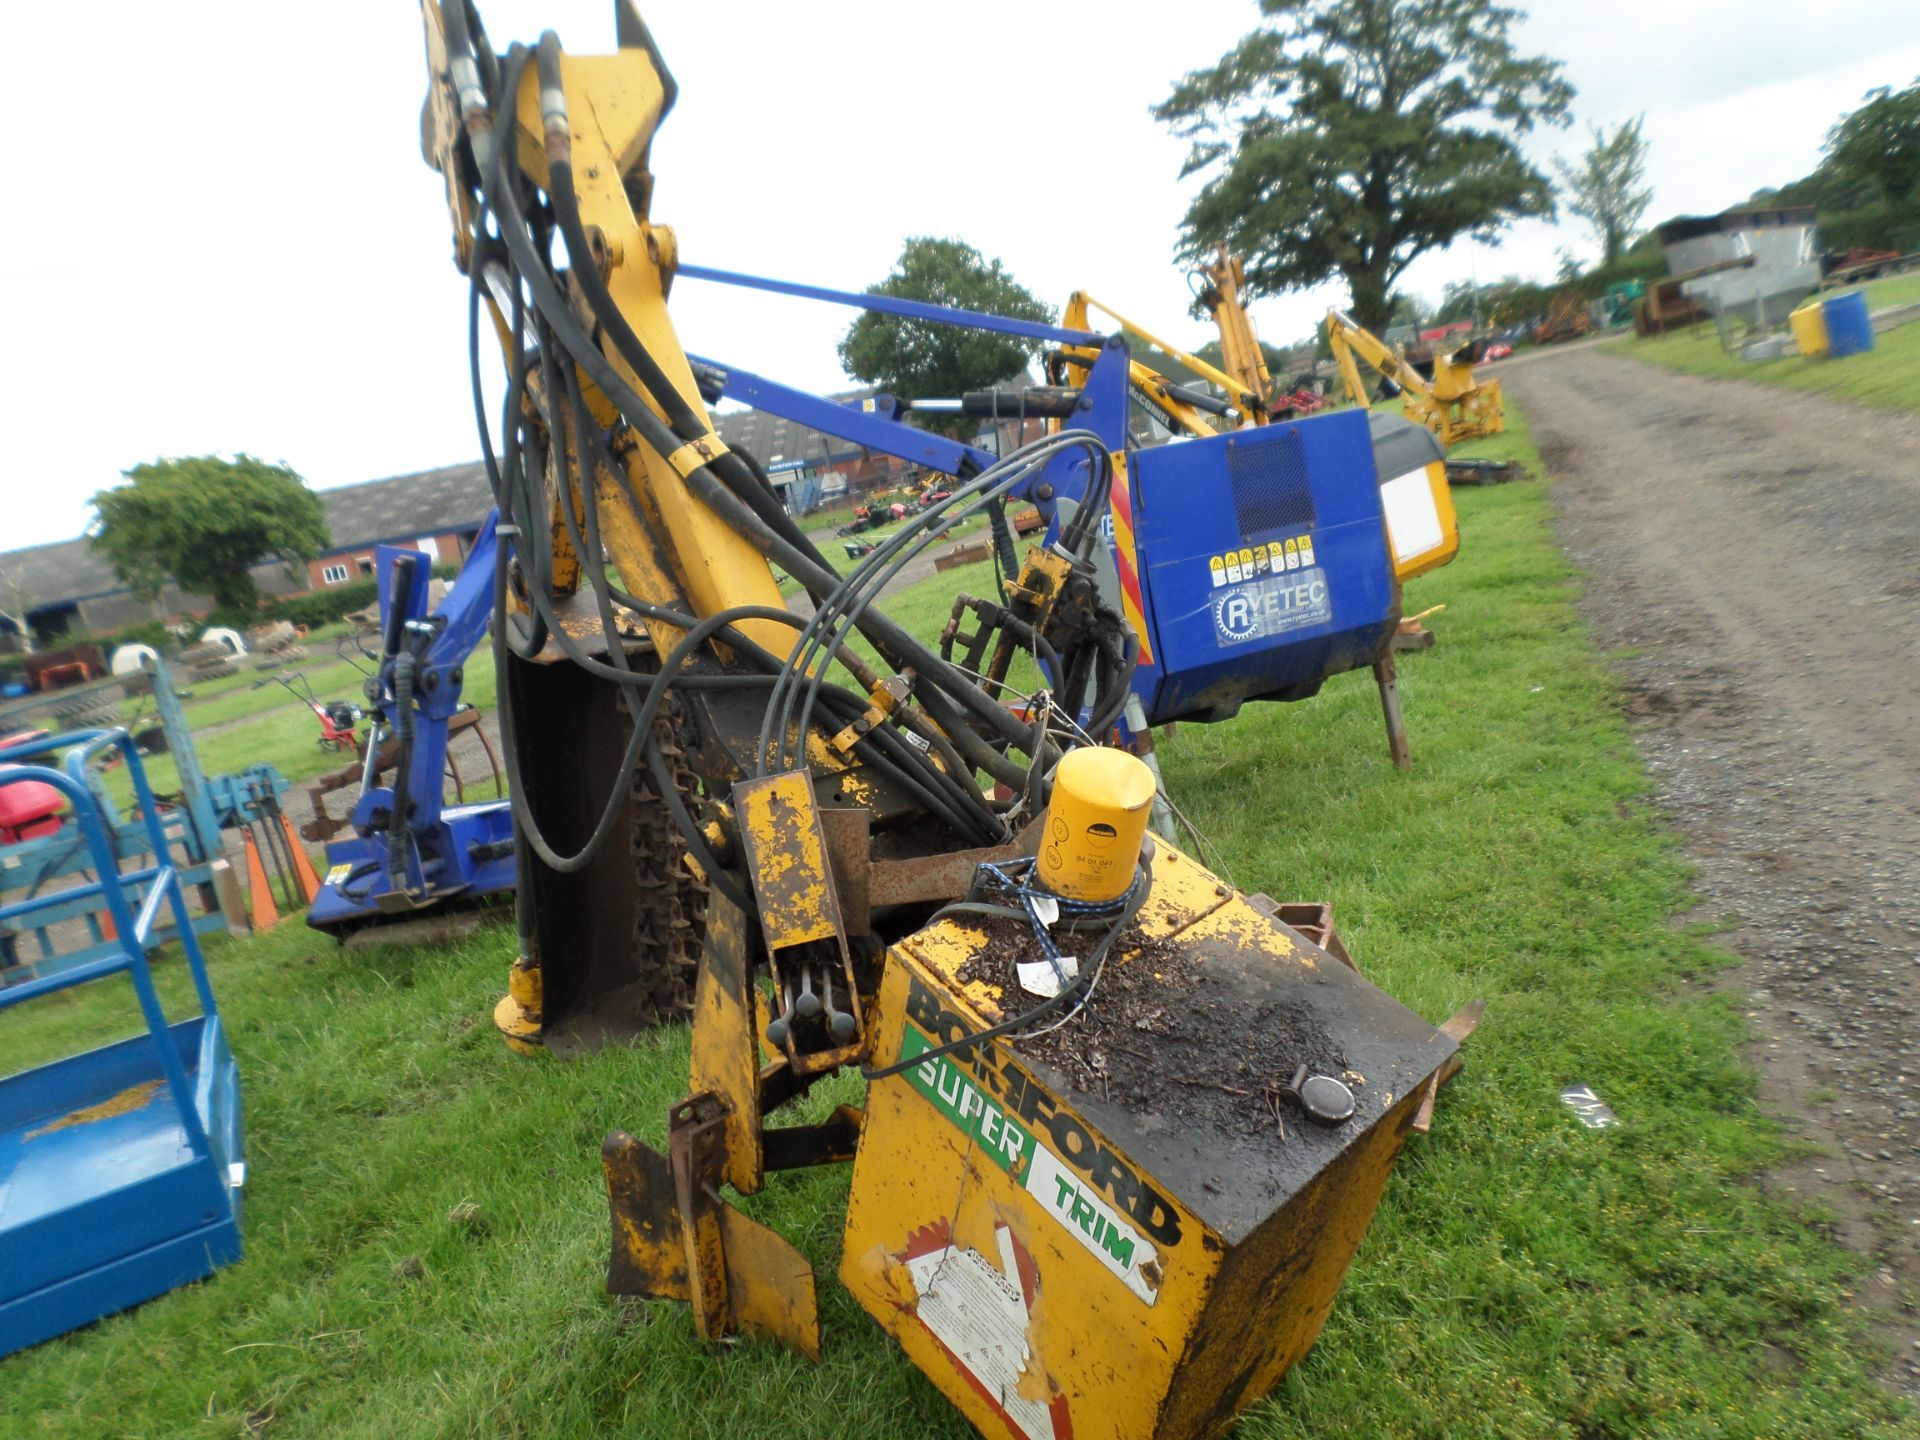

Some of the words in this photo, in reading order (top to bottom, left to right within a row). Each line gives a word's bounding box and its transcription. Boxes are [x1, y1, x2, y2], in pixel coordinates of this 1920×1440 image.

[1228, 581, 1325, 629] RYETEC
[918, 1046, 1024, 1162] SUPER
[1054, 1173, 1135, 1270] TRIM
